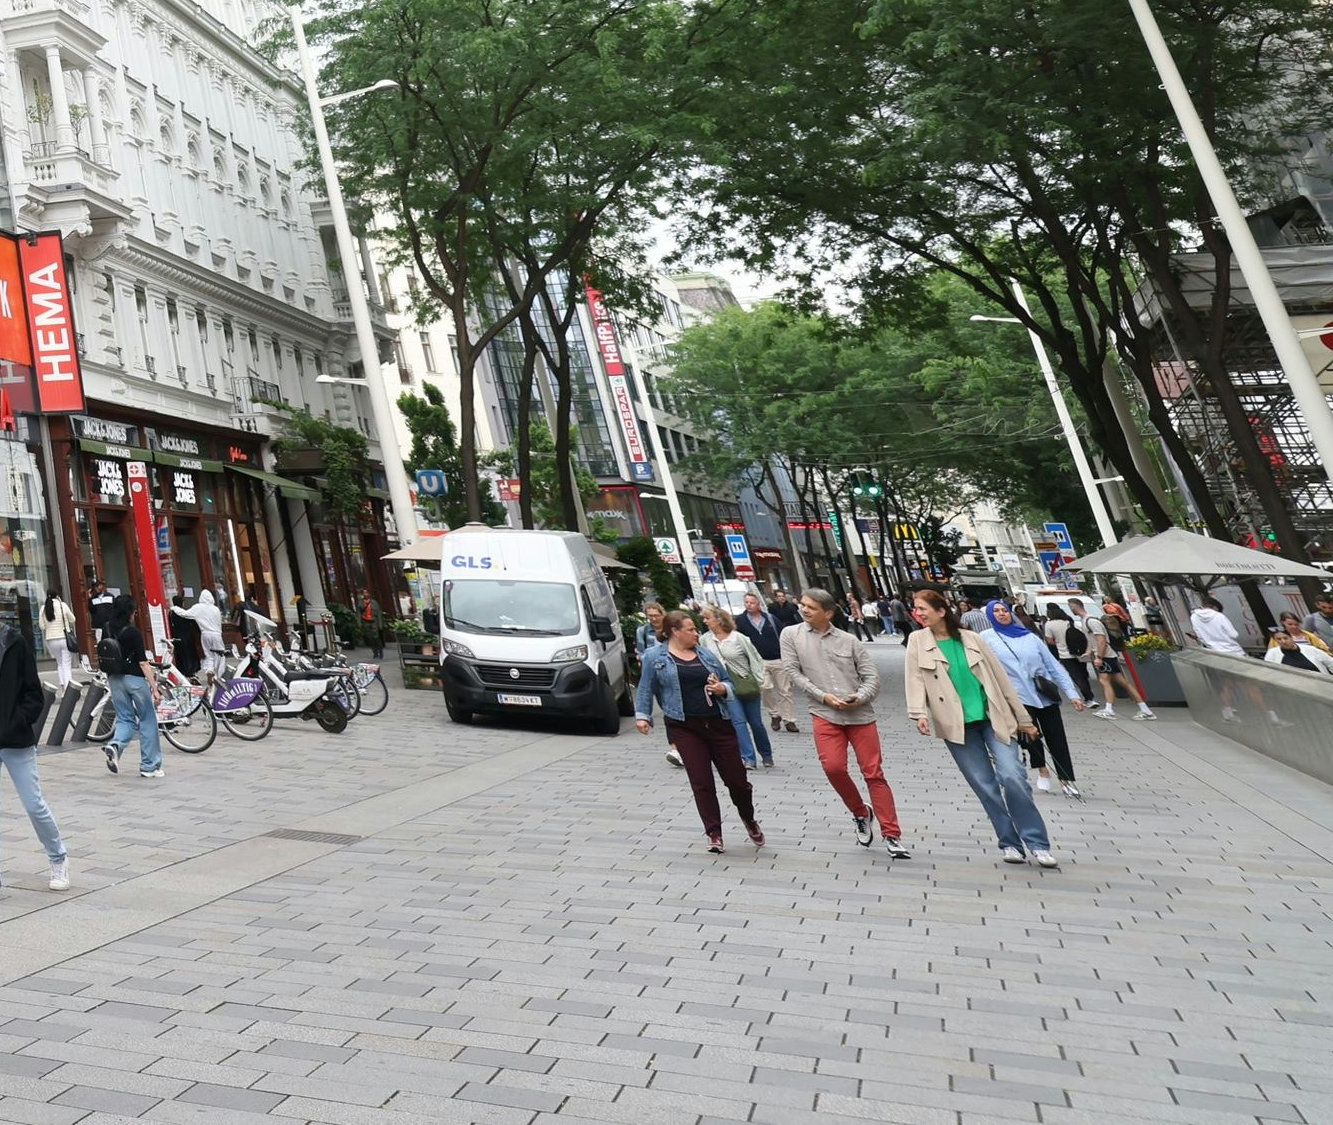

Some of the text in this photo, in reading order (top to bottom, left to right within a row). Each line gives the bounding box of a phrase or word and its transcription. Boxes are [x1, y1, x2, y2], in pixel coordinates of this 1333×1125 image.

[29, 262, 74, 382] HEMA
[614, 386, 643, 457] EUROSPAR
[420, 475, 438, 492] U
